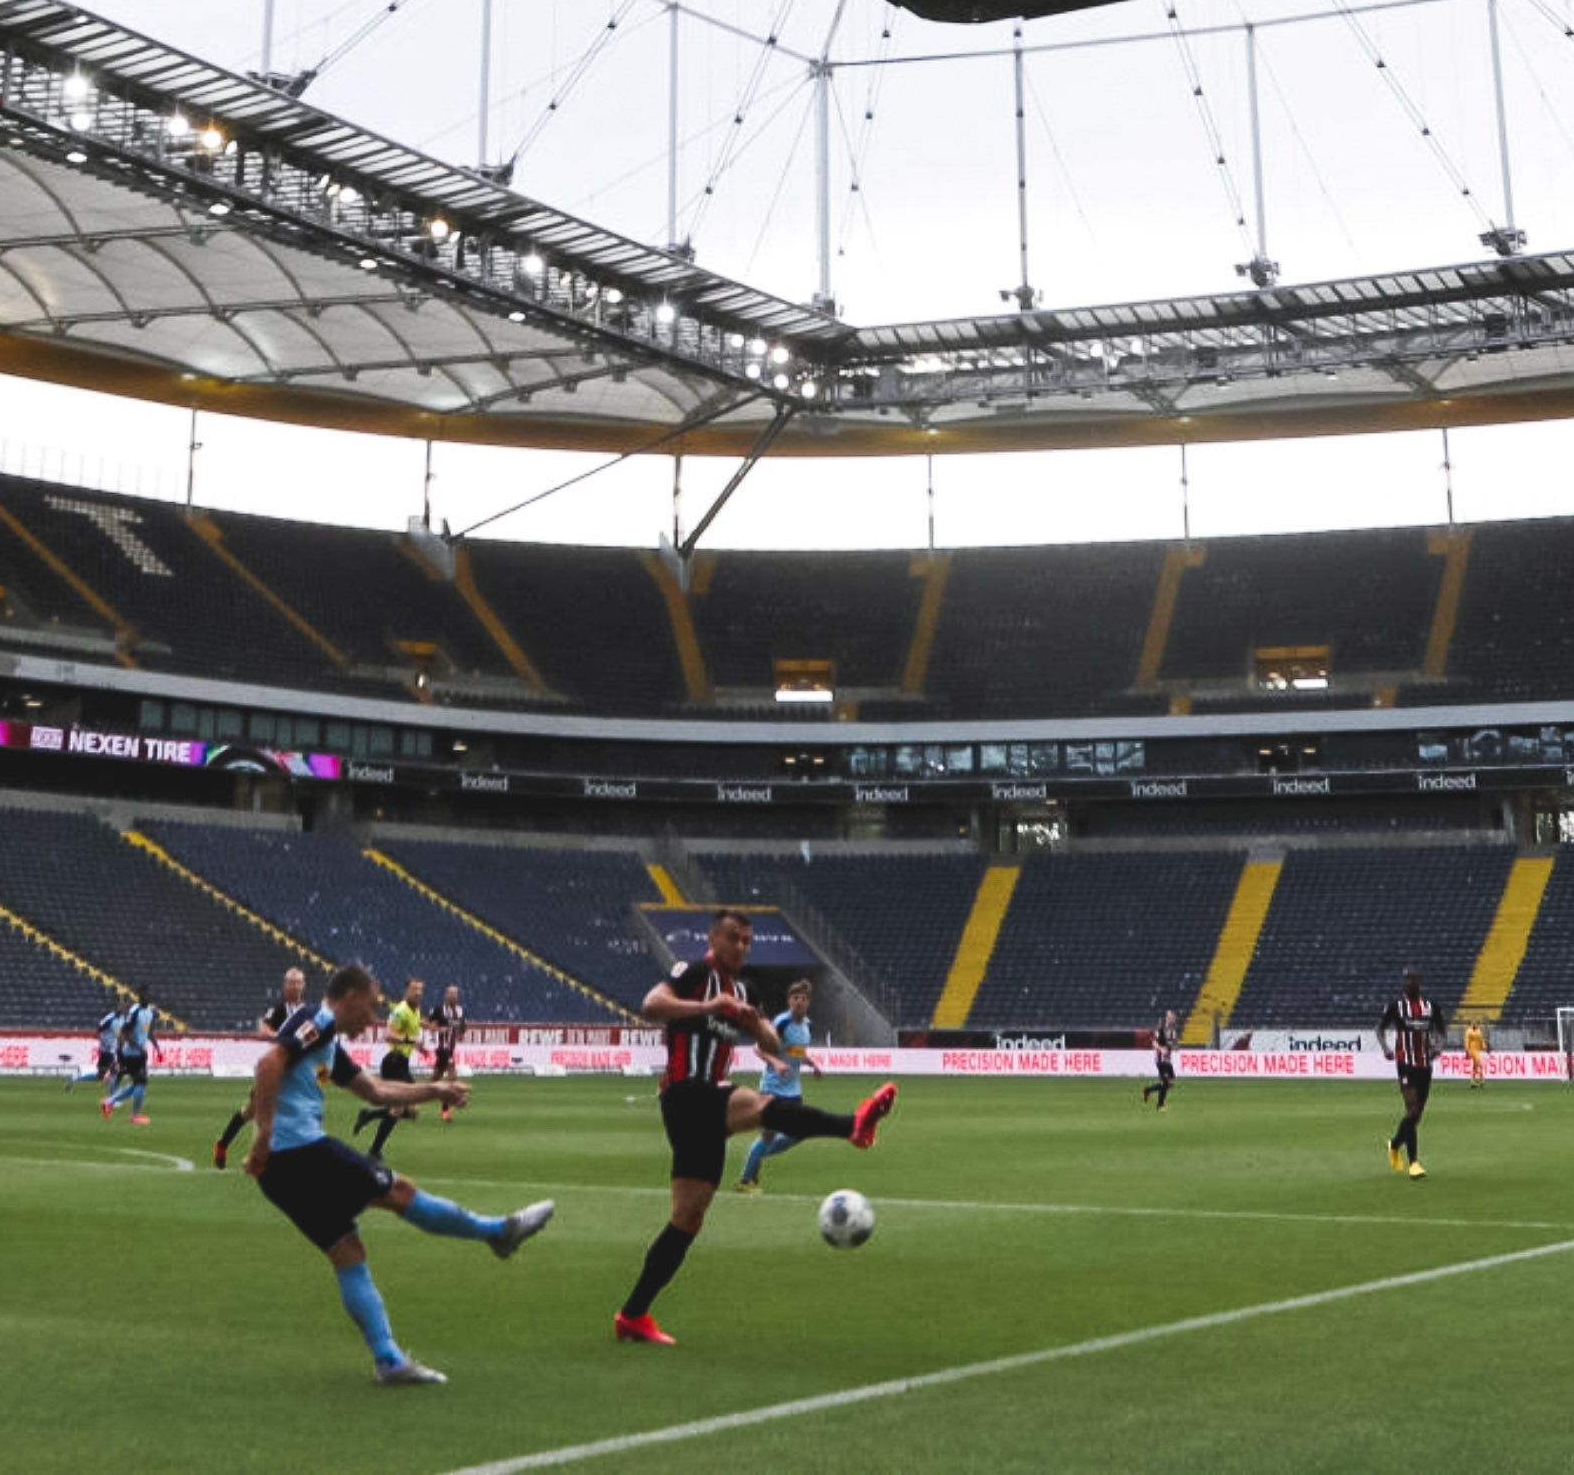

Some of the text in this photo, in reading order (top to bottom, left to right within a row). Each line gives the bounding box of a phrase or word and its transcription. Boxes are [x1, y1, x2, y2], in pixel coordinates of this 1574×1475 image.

[68, 729, 140, 758] NEXEN
[144, 737, 192, 764] TIRE
[996, 1034, 1066, 1050] indeed
[1288, 1035, 1362, 1051] indeed
[942, 1052, 1101, 1072] PRECISION MADE HERE
[1180, 1054, 1355, 1075] PRECISION MADE HERE
[1440, 1055, 1526, 1075] PREISION
